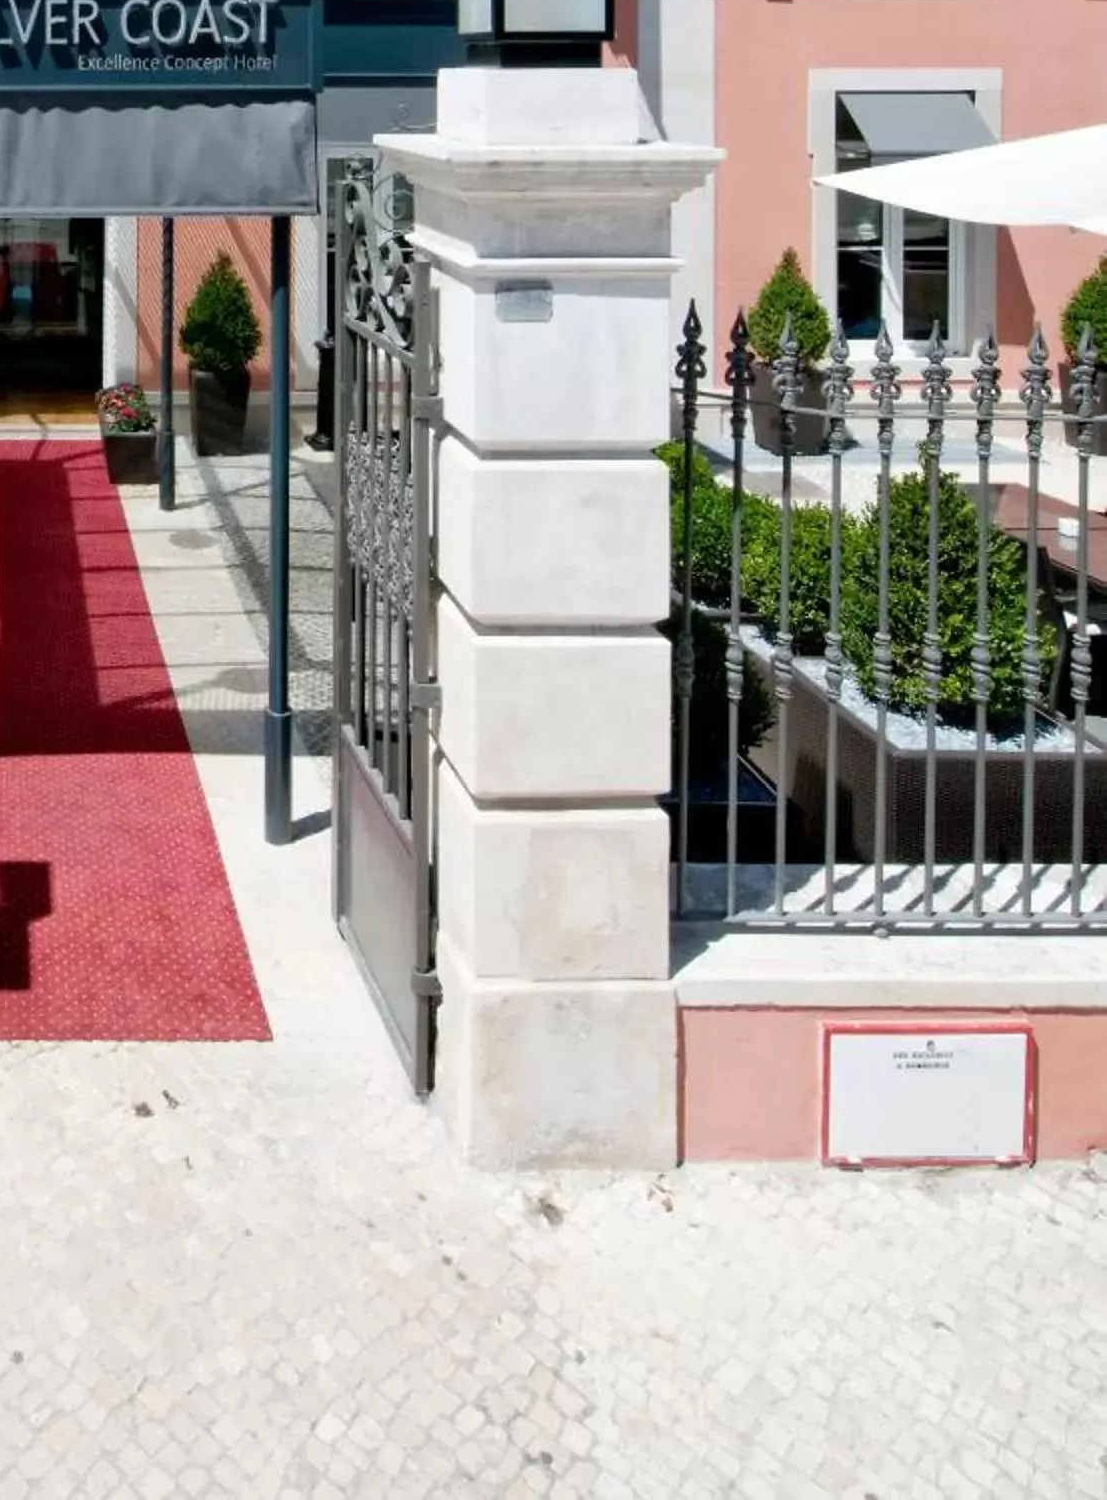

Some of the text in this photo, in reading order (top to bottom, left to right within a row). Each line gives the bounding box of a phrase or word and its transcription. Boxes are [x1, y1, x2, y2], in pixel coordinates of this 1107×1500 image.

[77, 53, 279, 74] Excellence Concept Hotel
